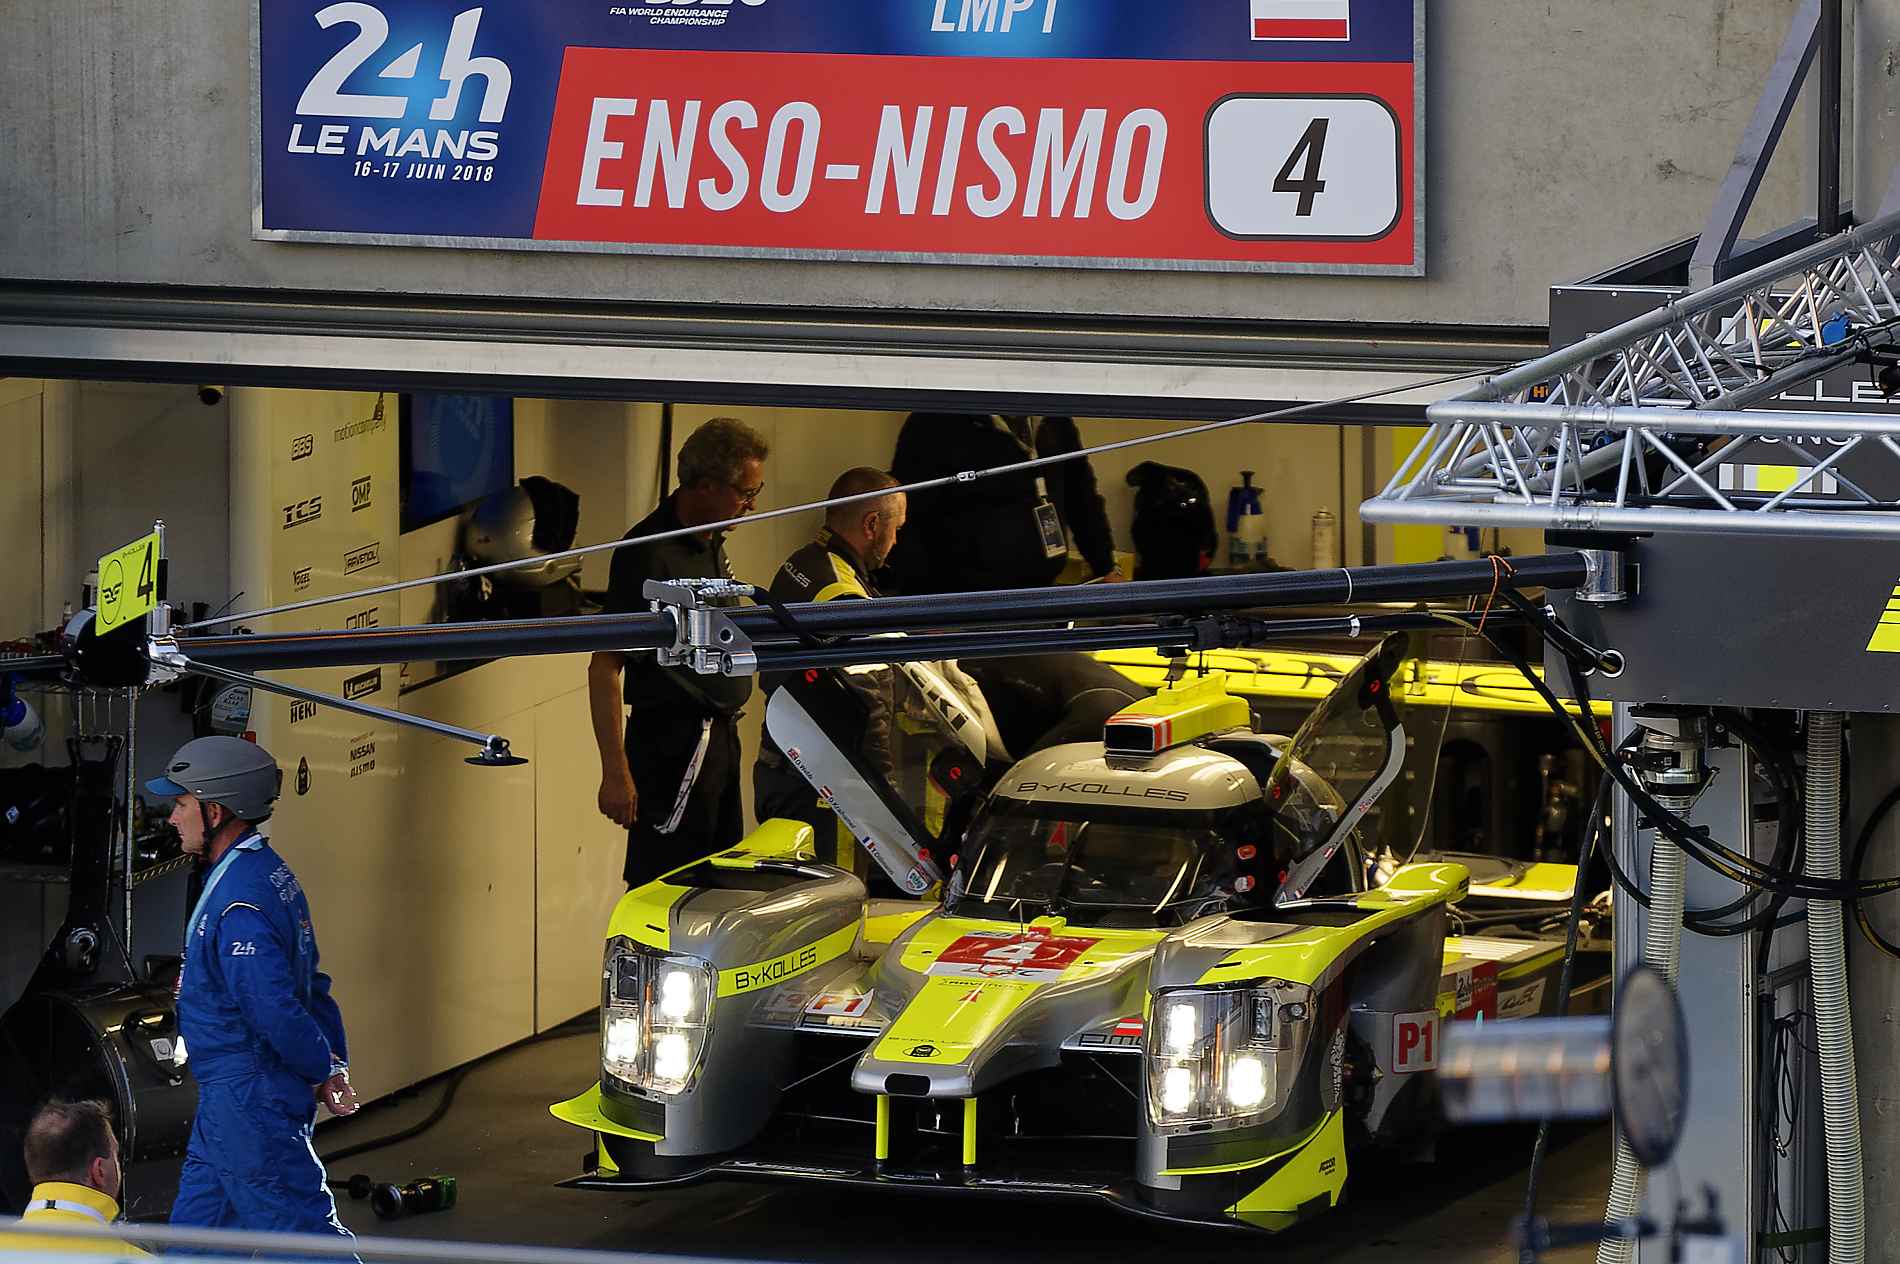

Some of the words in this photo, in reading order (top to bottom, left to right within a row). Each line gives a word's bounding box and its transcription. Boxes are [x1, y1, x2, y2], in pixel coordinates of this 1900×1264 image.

[609, 7, 627, 15] FIA
[628, 8, 663, 16] WORLD
[664, 9, 729, 18] ENDURANCE
[649, 17, 726, 26] CHAMPIONSHIP
[295, 1, 512, 123] 24h
[287, 123, 350, 155] LE
[356, 126, 499, 161] MANS
[576, 97, 1168, 221] ENSO-NISMO
[353, 161, 401, 178] 16-17
[406, 163, 447, 180] JUIN
[451, 165, 494, 182] 2018
[1272, 118, 1330, 217] 4
[283, 496, 322, 524] TCS
[137, 541, 154, 606] 4
[981, 941, 1042, 965] 4
[1399, 1020, 1433, 1065] P1
